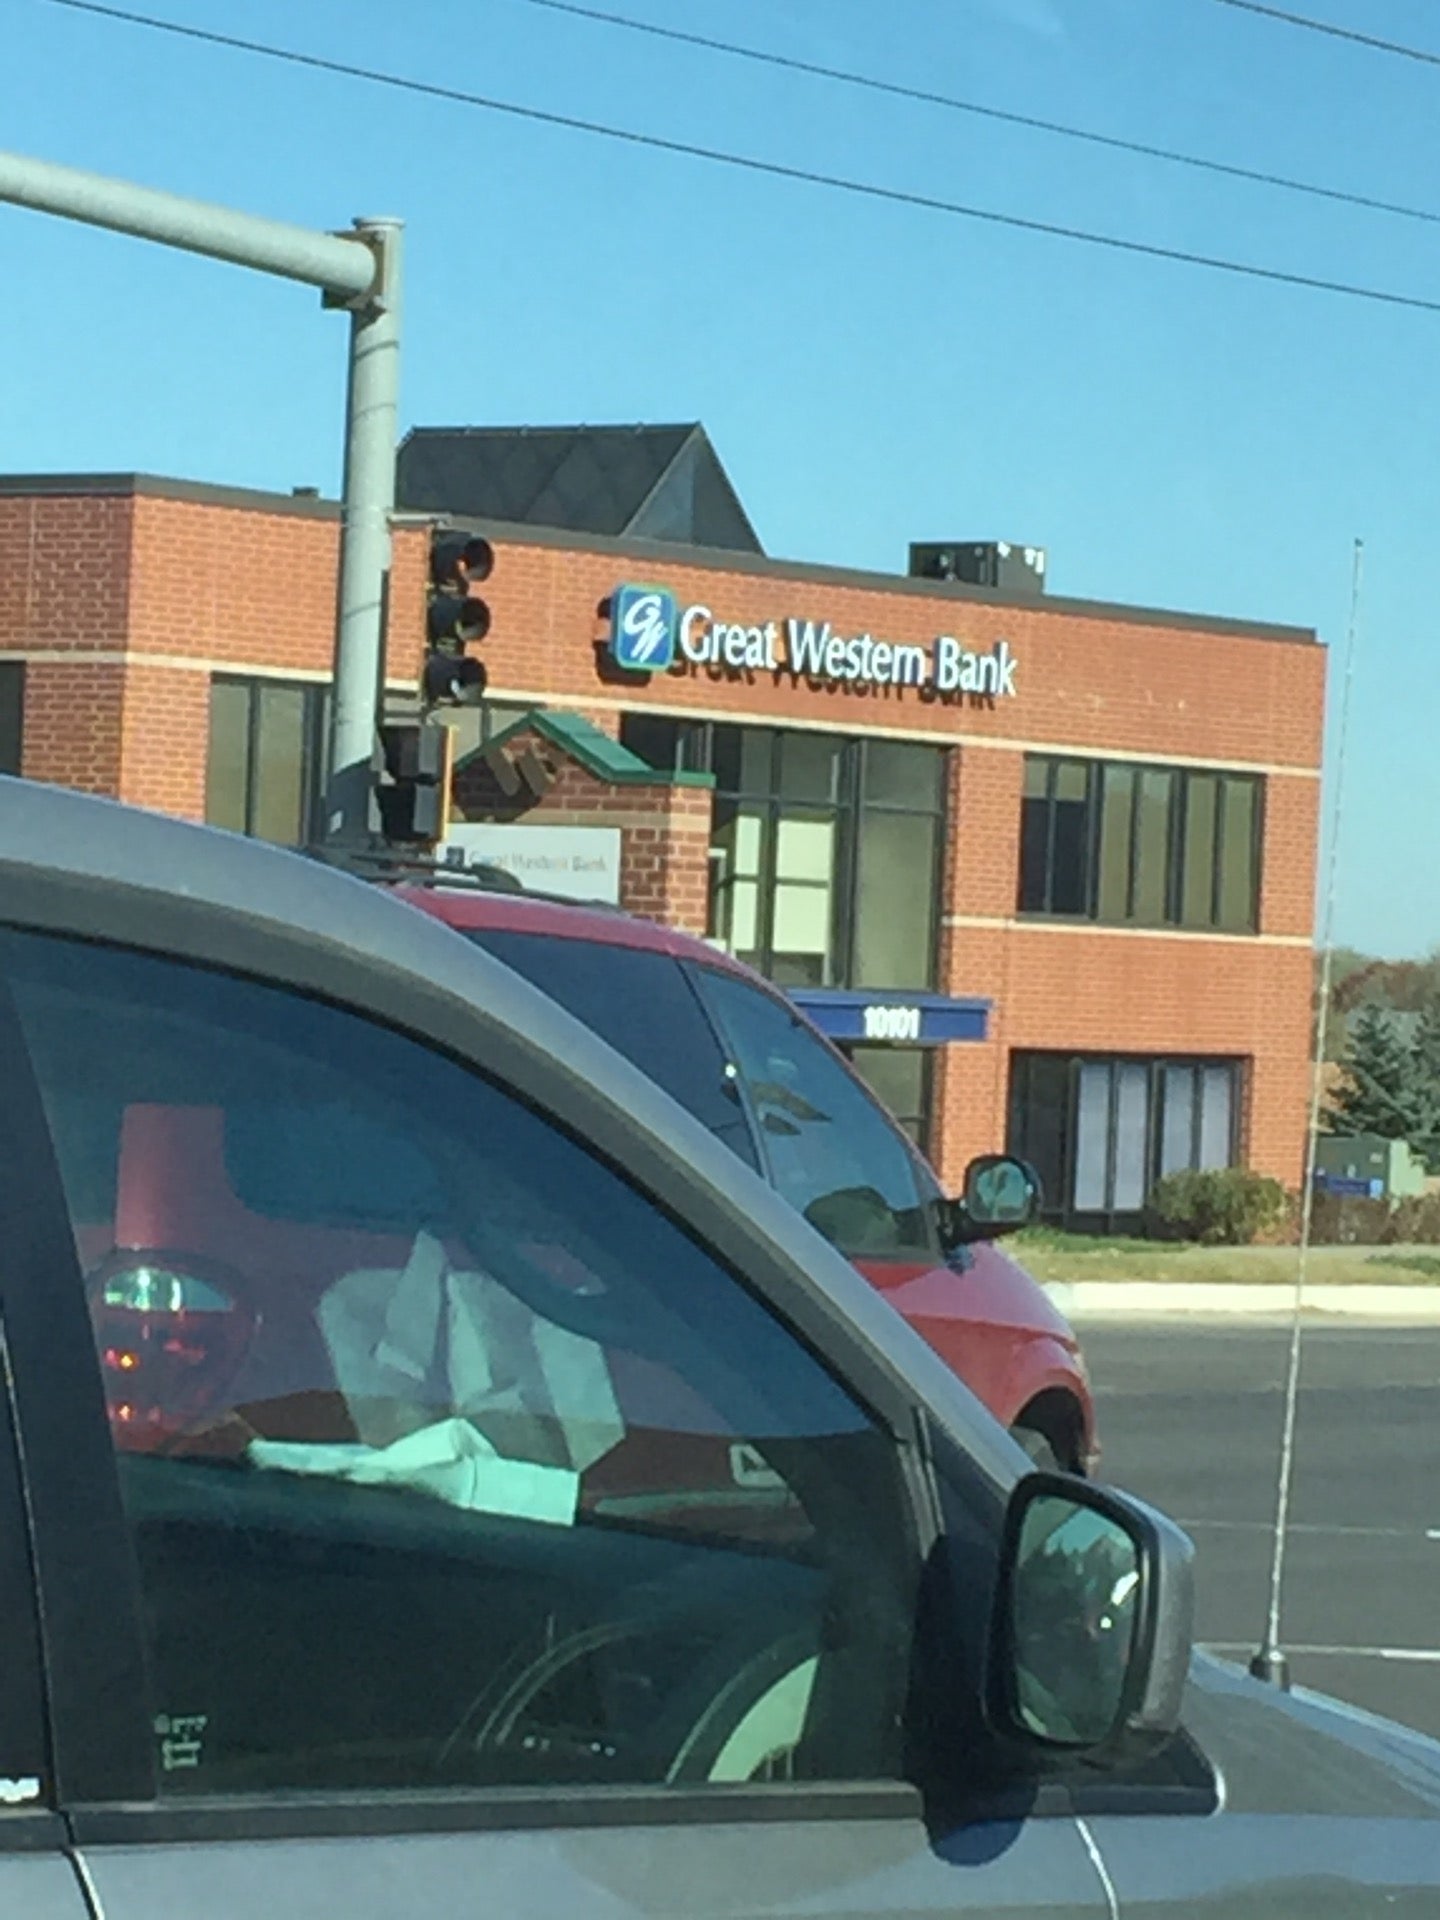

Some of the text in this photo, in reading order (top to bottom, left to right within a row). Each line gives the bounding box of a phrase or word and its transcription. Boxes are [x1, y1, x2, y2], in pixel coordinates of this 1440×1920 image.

[680, 606, 777, 669] Great
[788, 618, 925, 685] Western
[935, 637, 1017, 696] Bank
[864, 1006, 919, 1039] 10101
